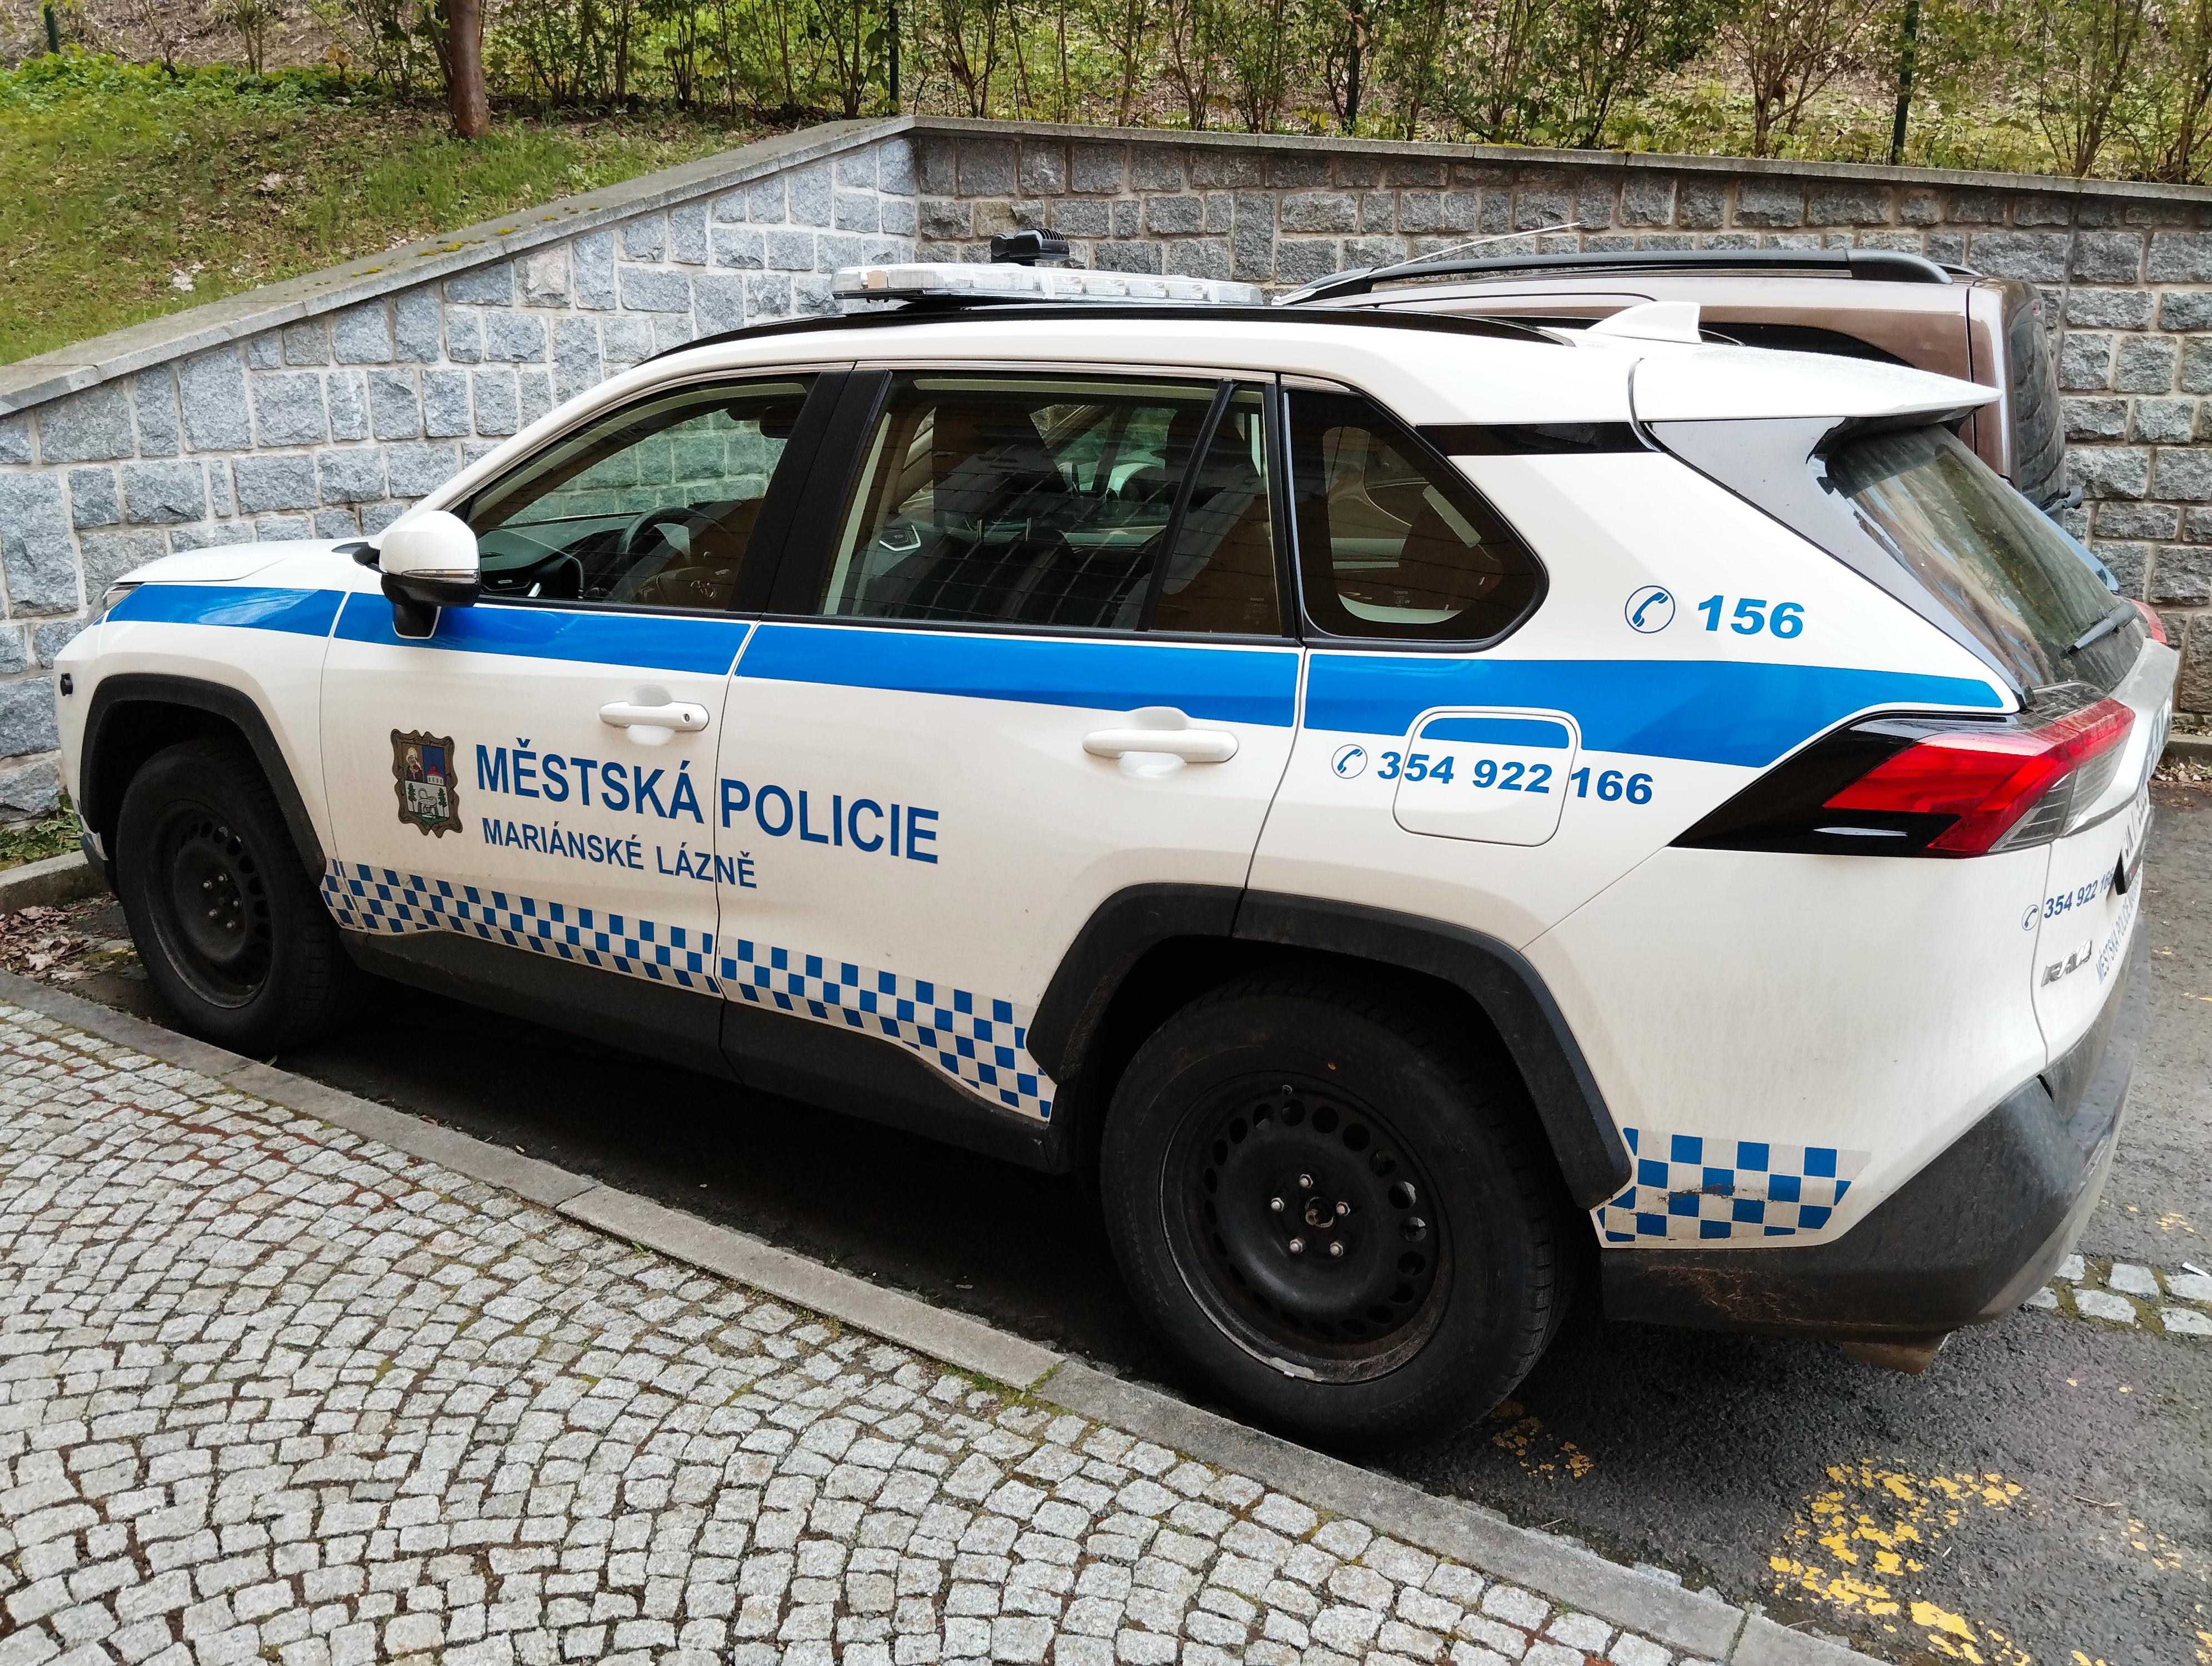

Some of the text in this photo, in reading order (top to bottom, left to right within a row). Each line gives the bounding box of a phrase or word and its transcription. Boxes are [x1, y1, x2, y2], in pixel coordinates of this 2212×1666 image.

[1698, 595, 1804, 639] 156
[476, 737, 939, 864] MĚSTSKÁ POLICIE
[1378, 751, 1653, 805] 354 922 166
[482, 817, 757, 889] MARIÁNSKÉ LÁZNĚ
[2044, 891, 2073, 919] 354
[2076, 879, 2098, 907] 922
